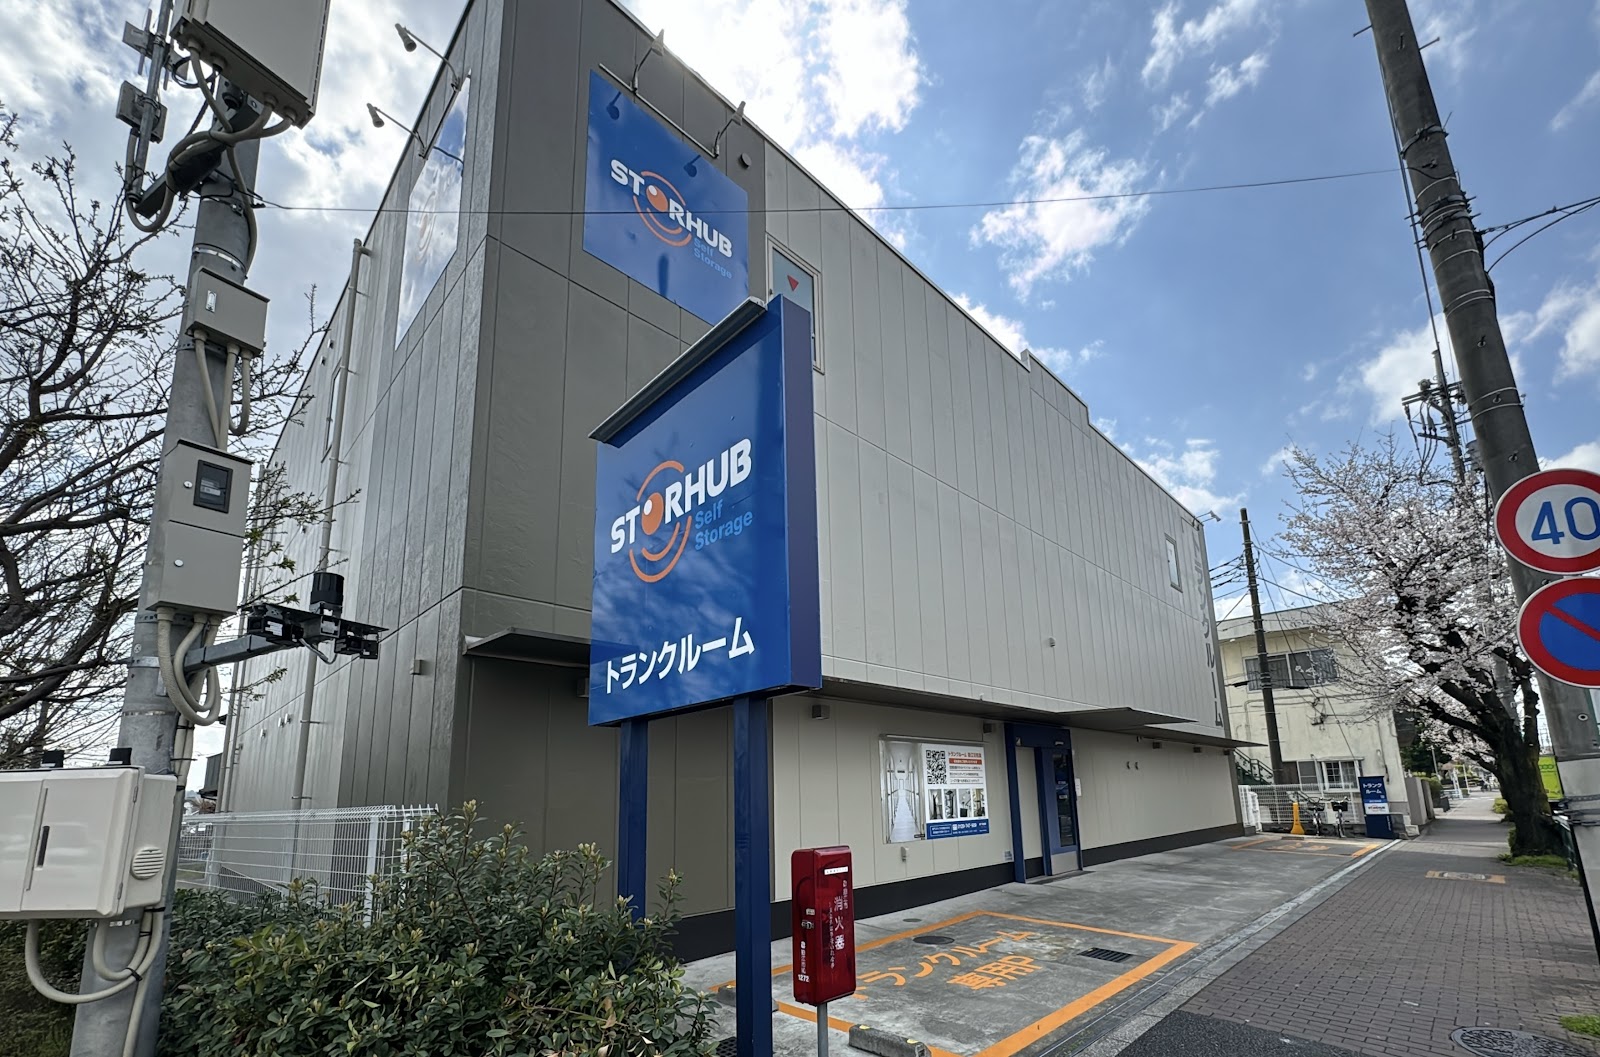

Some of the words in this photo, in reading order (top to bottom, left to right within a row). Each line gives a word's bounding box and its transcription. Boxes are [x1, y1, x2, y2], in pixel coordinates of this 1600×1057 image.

[611, 159, 732, 257] STORHUB
[693, 248, 733, 279] Storage
[694, 237, 715, 257] Self
[610, 438, 752, 554] STORHUB
[694, 499, 724, 530] Self
[694, 510, 753, 551] Storage
[1531, 497, 1600, 544] 40
[606, 617, 755, 694] トランクルーム
[834, 896, 845, 950] 消火器
[797, 974, 810, 983] 1272
[946, 955, 1041, 990] 専用P
